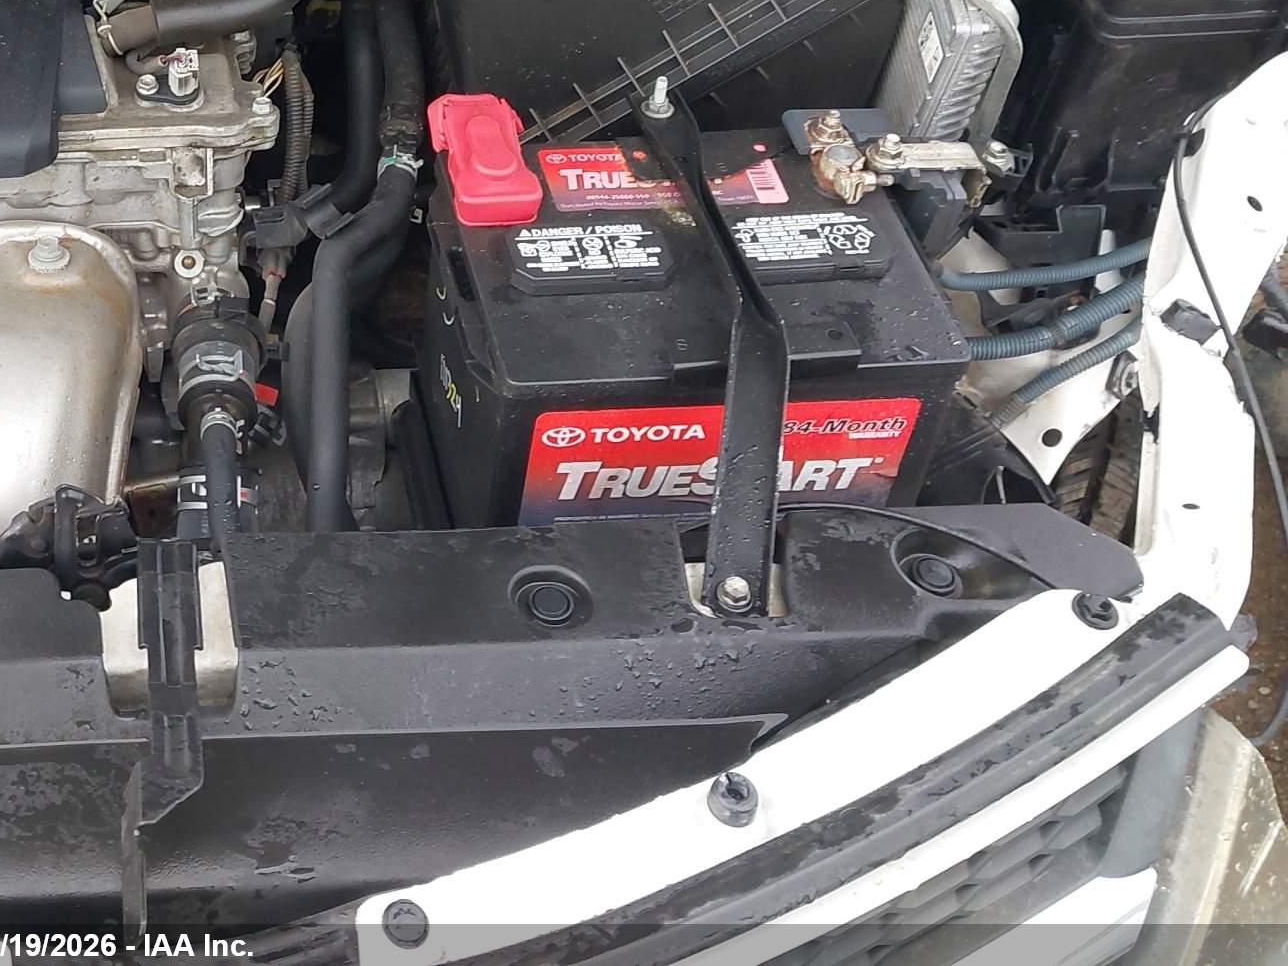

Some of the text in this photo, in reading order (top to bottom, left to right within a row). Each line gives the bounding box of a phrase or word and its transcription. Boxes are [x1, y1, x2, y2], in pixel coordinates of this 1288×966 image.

[531, 226, 584, 237] DANGER
[594, 223, 643, 235] POISON
[591, 424, 706, 443] TOYOTA
